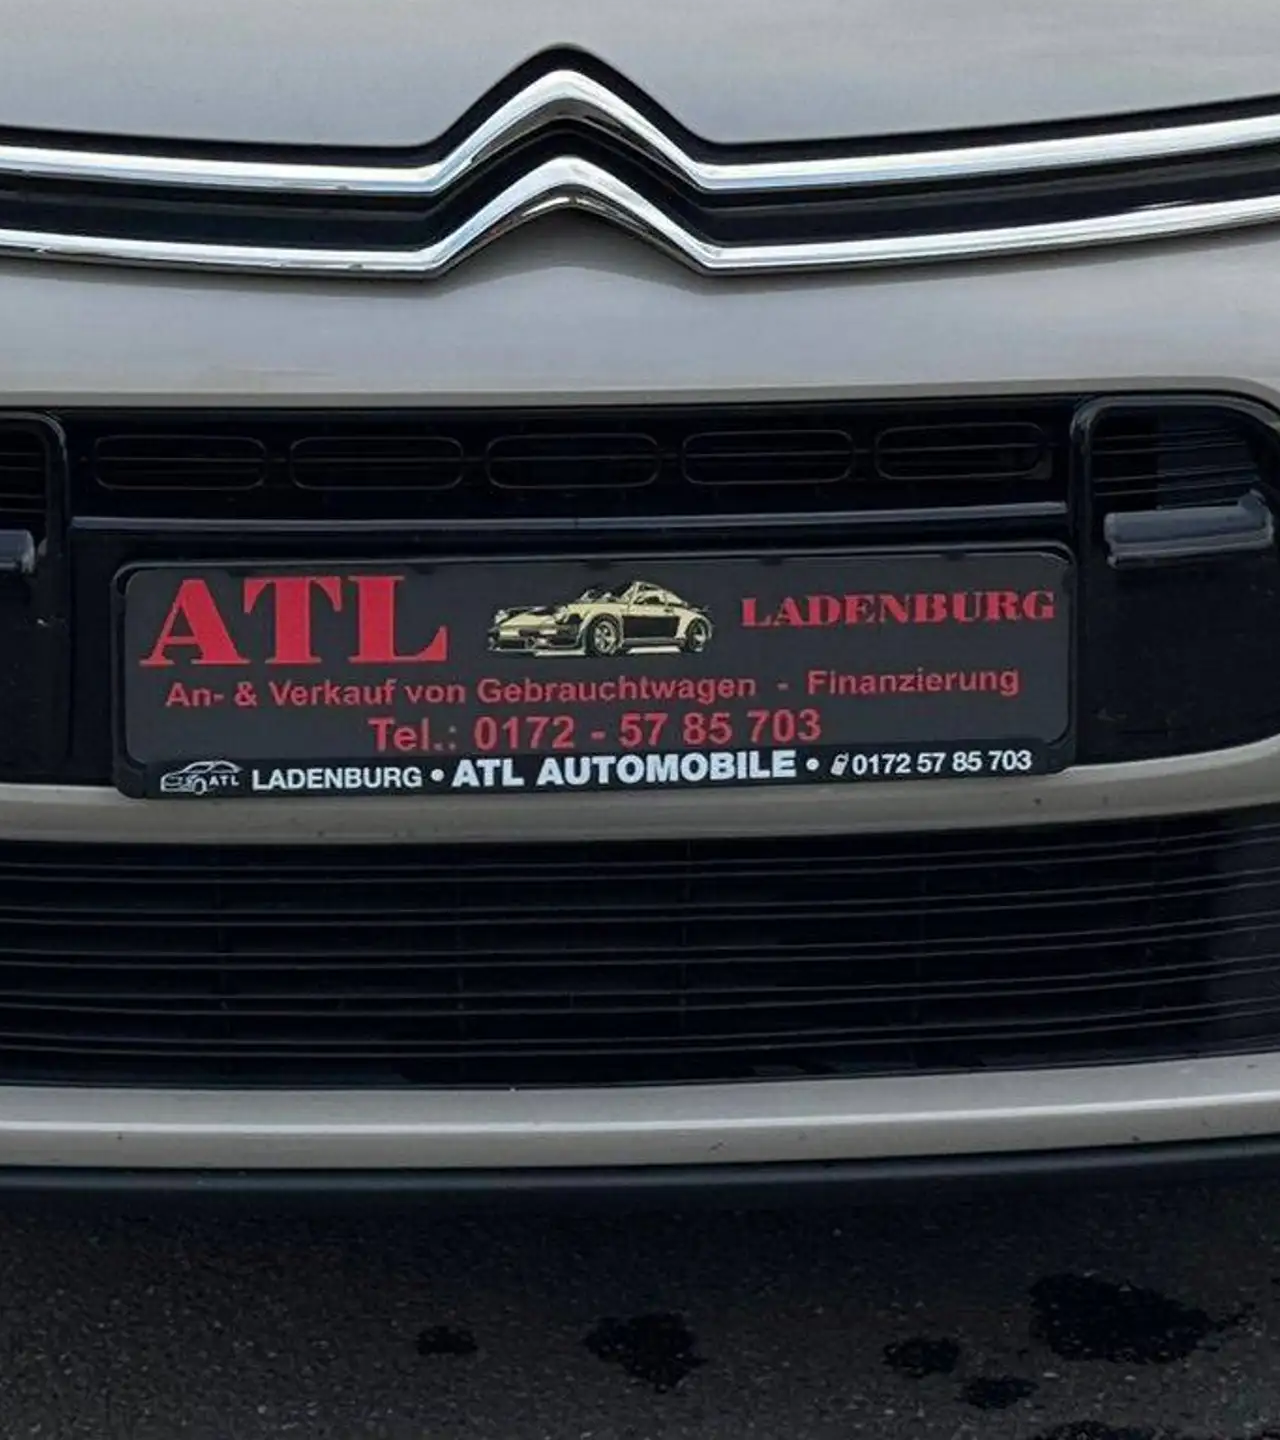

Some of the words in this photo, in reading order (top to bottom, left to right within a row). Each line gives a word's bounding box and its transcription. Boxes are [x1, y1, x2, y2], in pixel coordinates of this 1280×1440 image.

[139, 575, 448, 666] ATL
[741, 590, 1056, 628] LADENBURG
[166, 682, 224, 707] An-
[234, 682, 257, 706] &
[268, 678, 397, 707] Verkauf
[405, 684, 465, 703] von
[477, 675, 756, 705] Gebrauchtwagen
[807, 667, 1020, 697] Finanzierung
[369, 717, 457, 752] Tel.:
[474, 715, 575, 750] 0172
[619, 712, 668, 747] 57
[682, 712, 732, 746] 85
[747, 709, 821, 744] 703
[209, 775, 240, 787] ATL
[252, 766, 421, 790] LADENBURG
[451, 758, 524, 788] ATL
[536, 750, 797, 786] AUTOMOBILE
[852, 754, 911, 776] 0172
[916, 752, 946, 774] 57
[952, 751, 982, 773] 85
[989, 749, 1033, 772] 703
